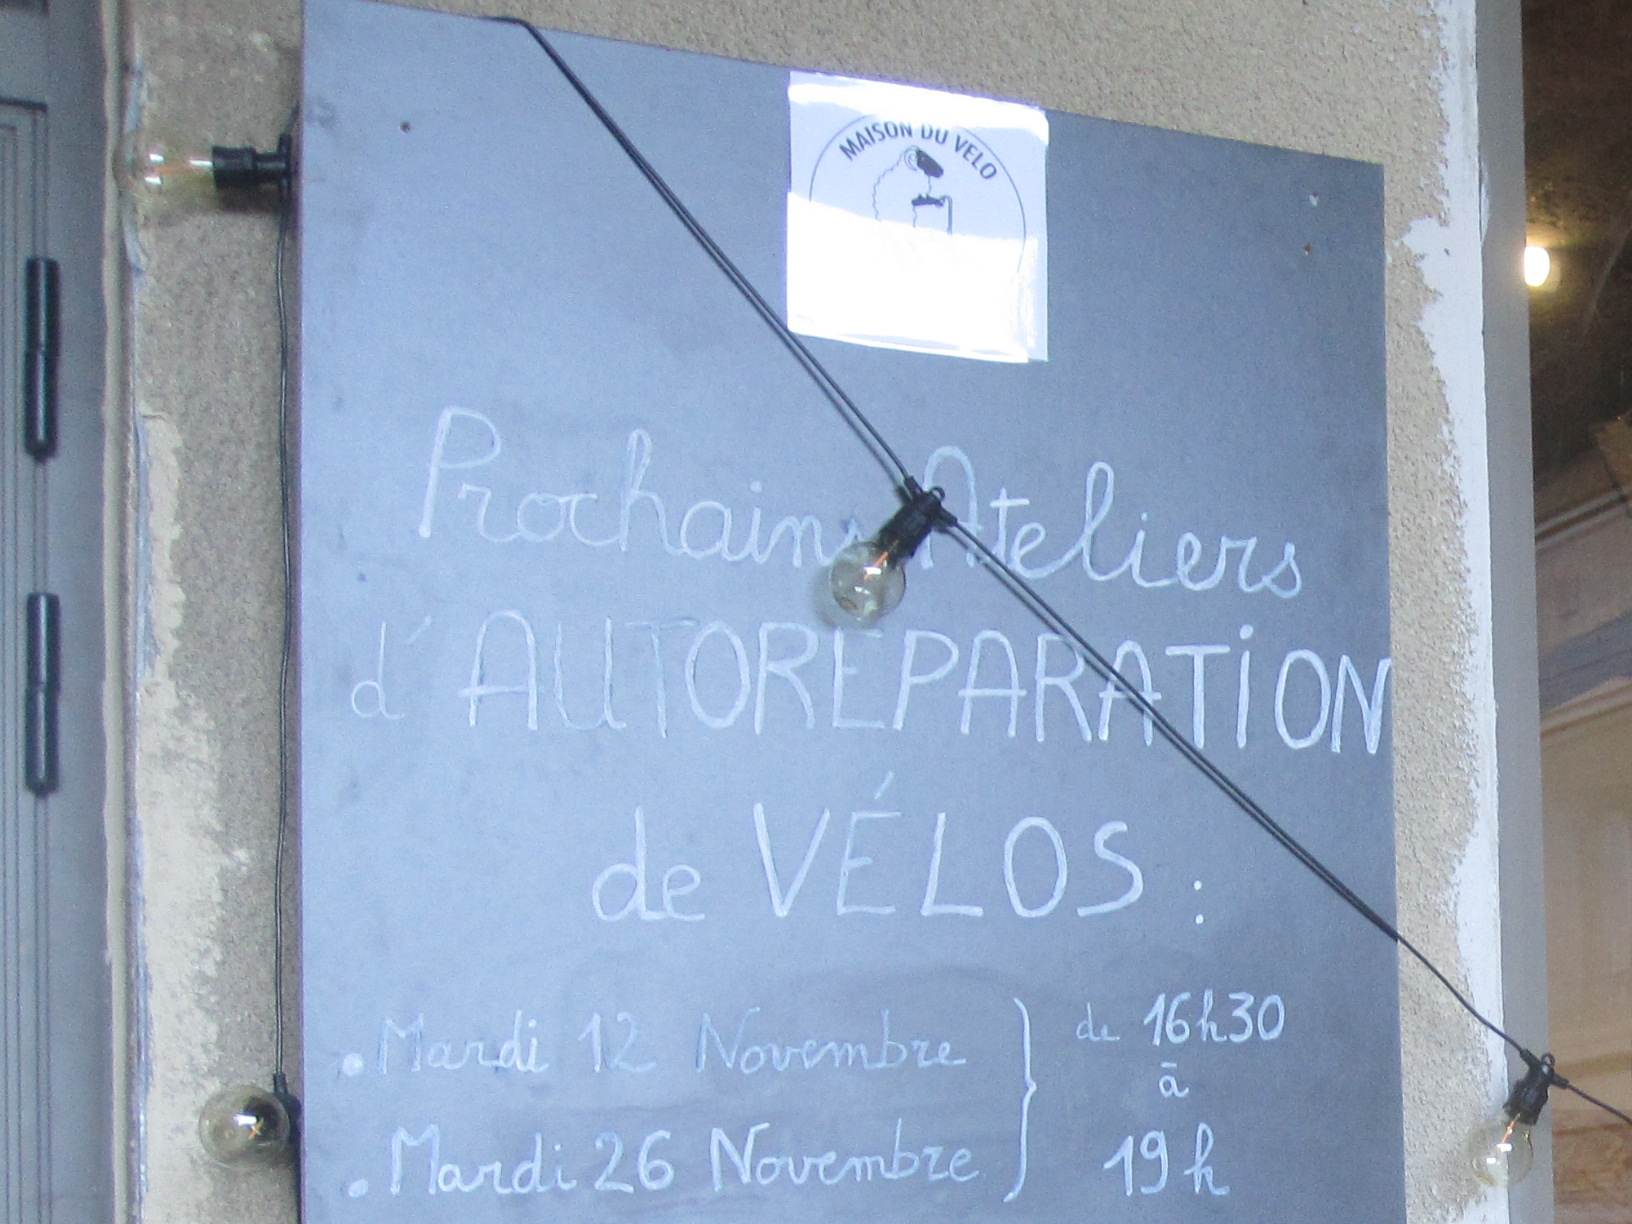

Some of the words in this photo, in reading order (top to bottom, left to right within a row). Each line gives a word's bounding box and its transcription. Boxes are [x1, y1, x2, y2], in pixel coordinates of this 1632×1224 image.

[838, 120, 913, 162] MAISON
[920, 123, 949, 145] DU
[954, 134, 998, 181] VELO
[921, 445, 1302, 598] Ateliers
[592, 805, 706, 922] de
[377, 1009, 550, 1075] Mardi
[578, 1011, 657, 1073] 12
[696, 1006, 967, 1075] Novembre
[1143, 987, 1286, 1046] 16h30
[391, 1123, 578, 1196] Mardi
[594, 1129, 675, 1194] 26
[710, 1117, 980, 1192] Novembre
